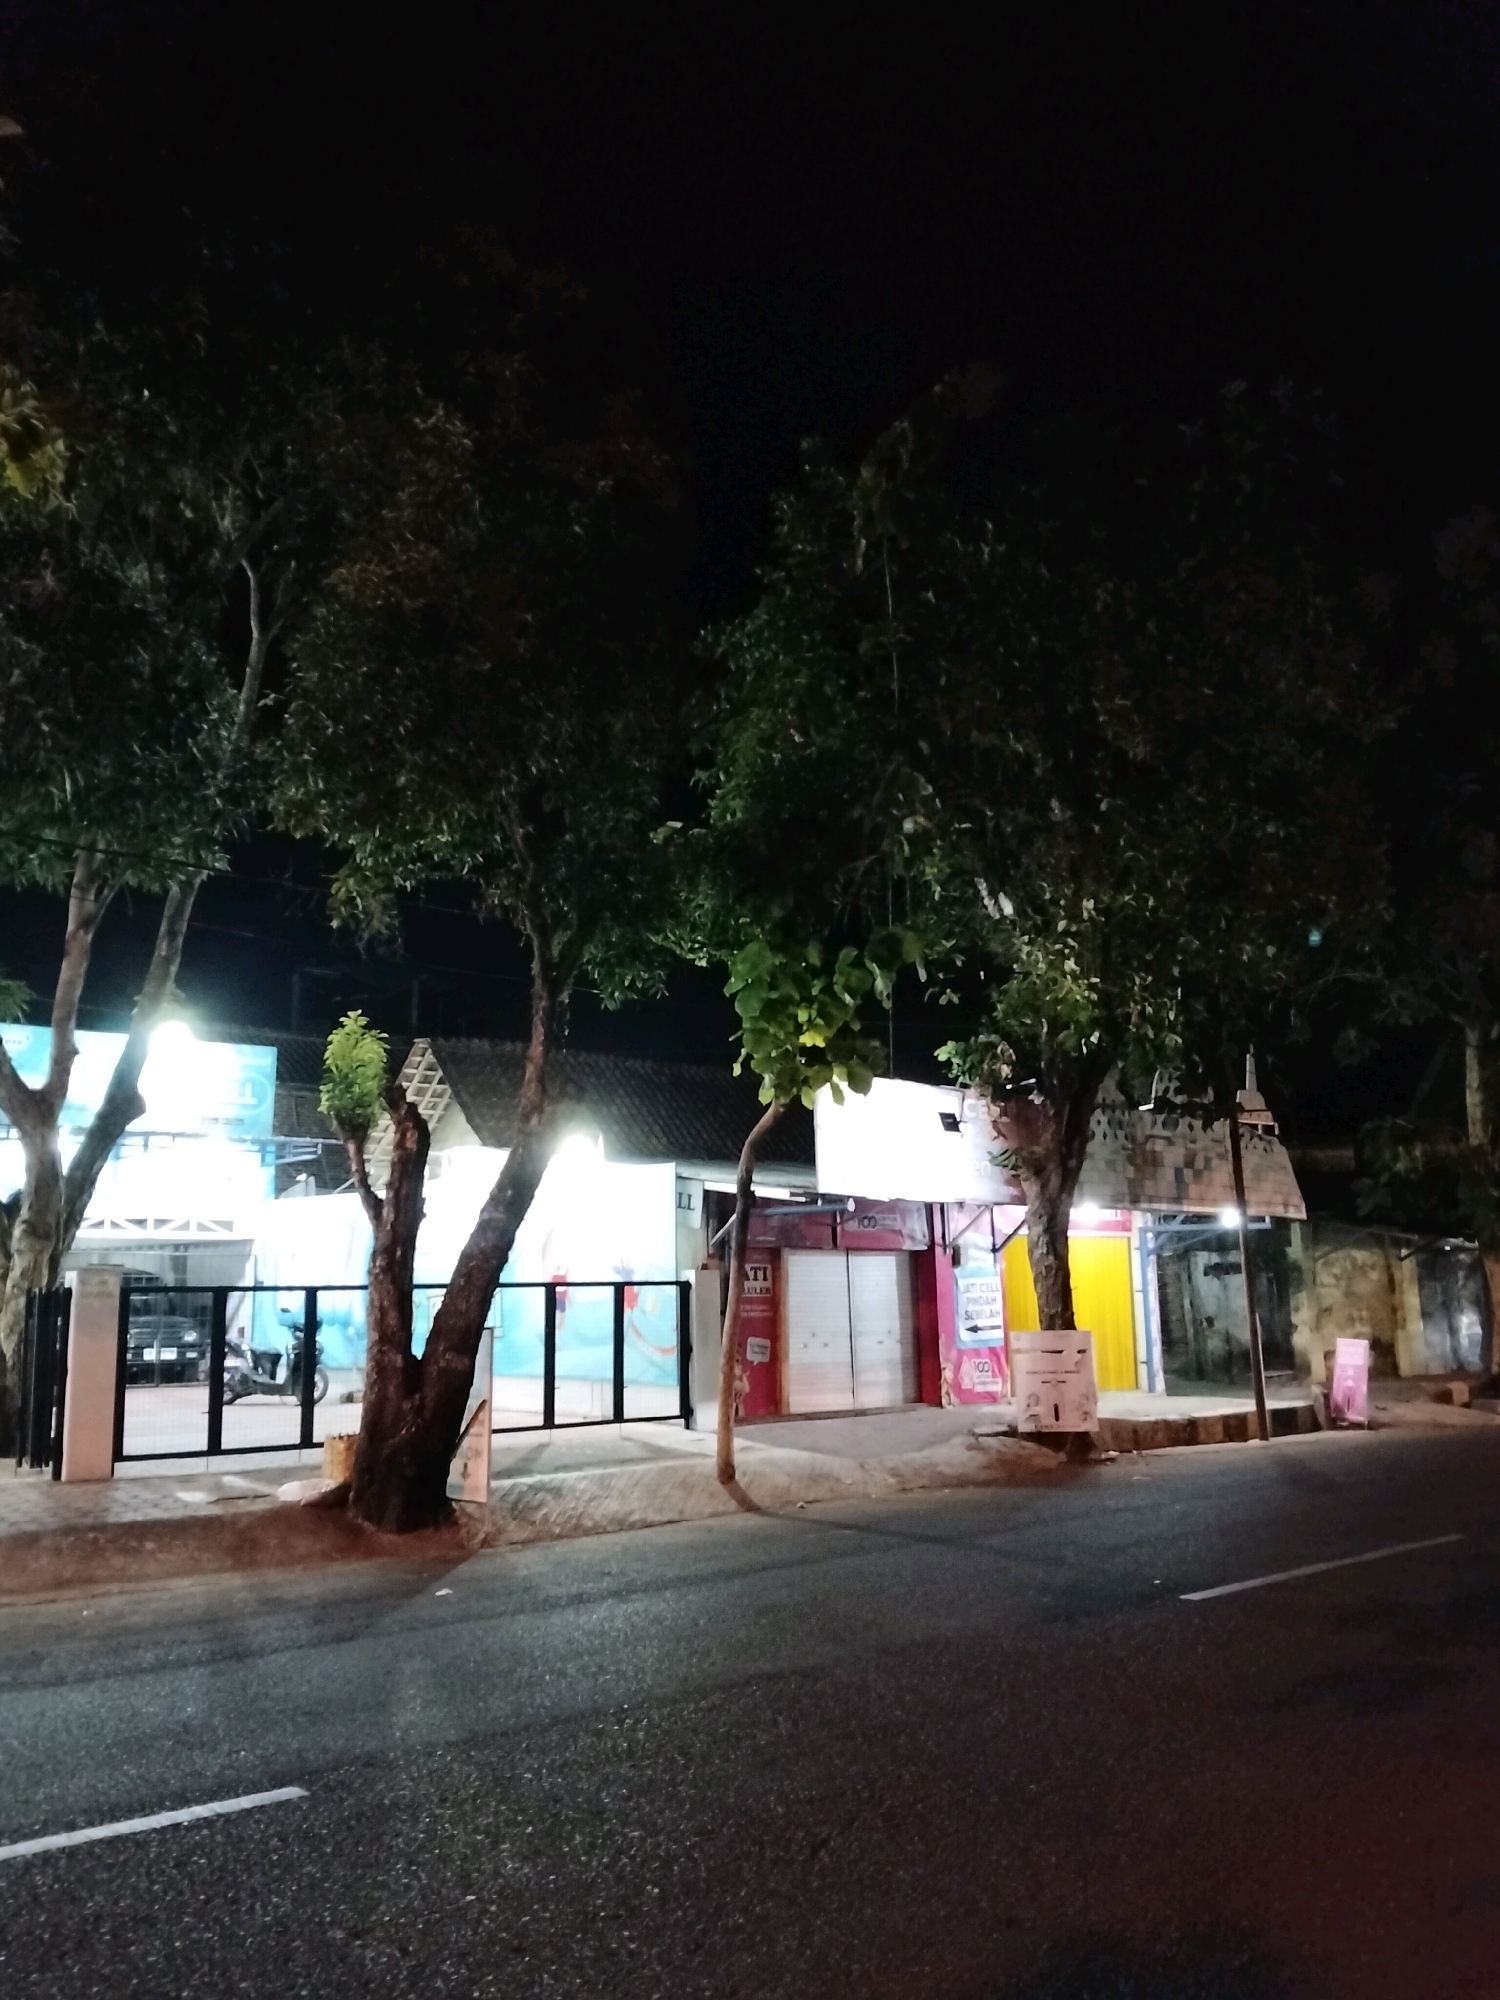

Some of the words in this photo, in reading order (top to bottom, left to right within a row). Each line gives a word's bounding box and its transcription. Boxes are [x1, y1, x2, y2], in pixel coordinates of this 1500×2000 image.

[962, 1283, 978, 1294] JATI
[980, 1282, 1000, 1292] CELL
[966, 1295, 997, 1307] PINDAH
[965, 1308, 1001, 1320] SEBELAH
